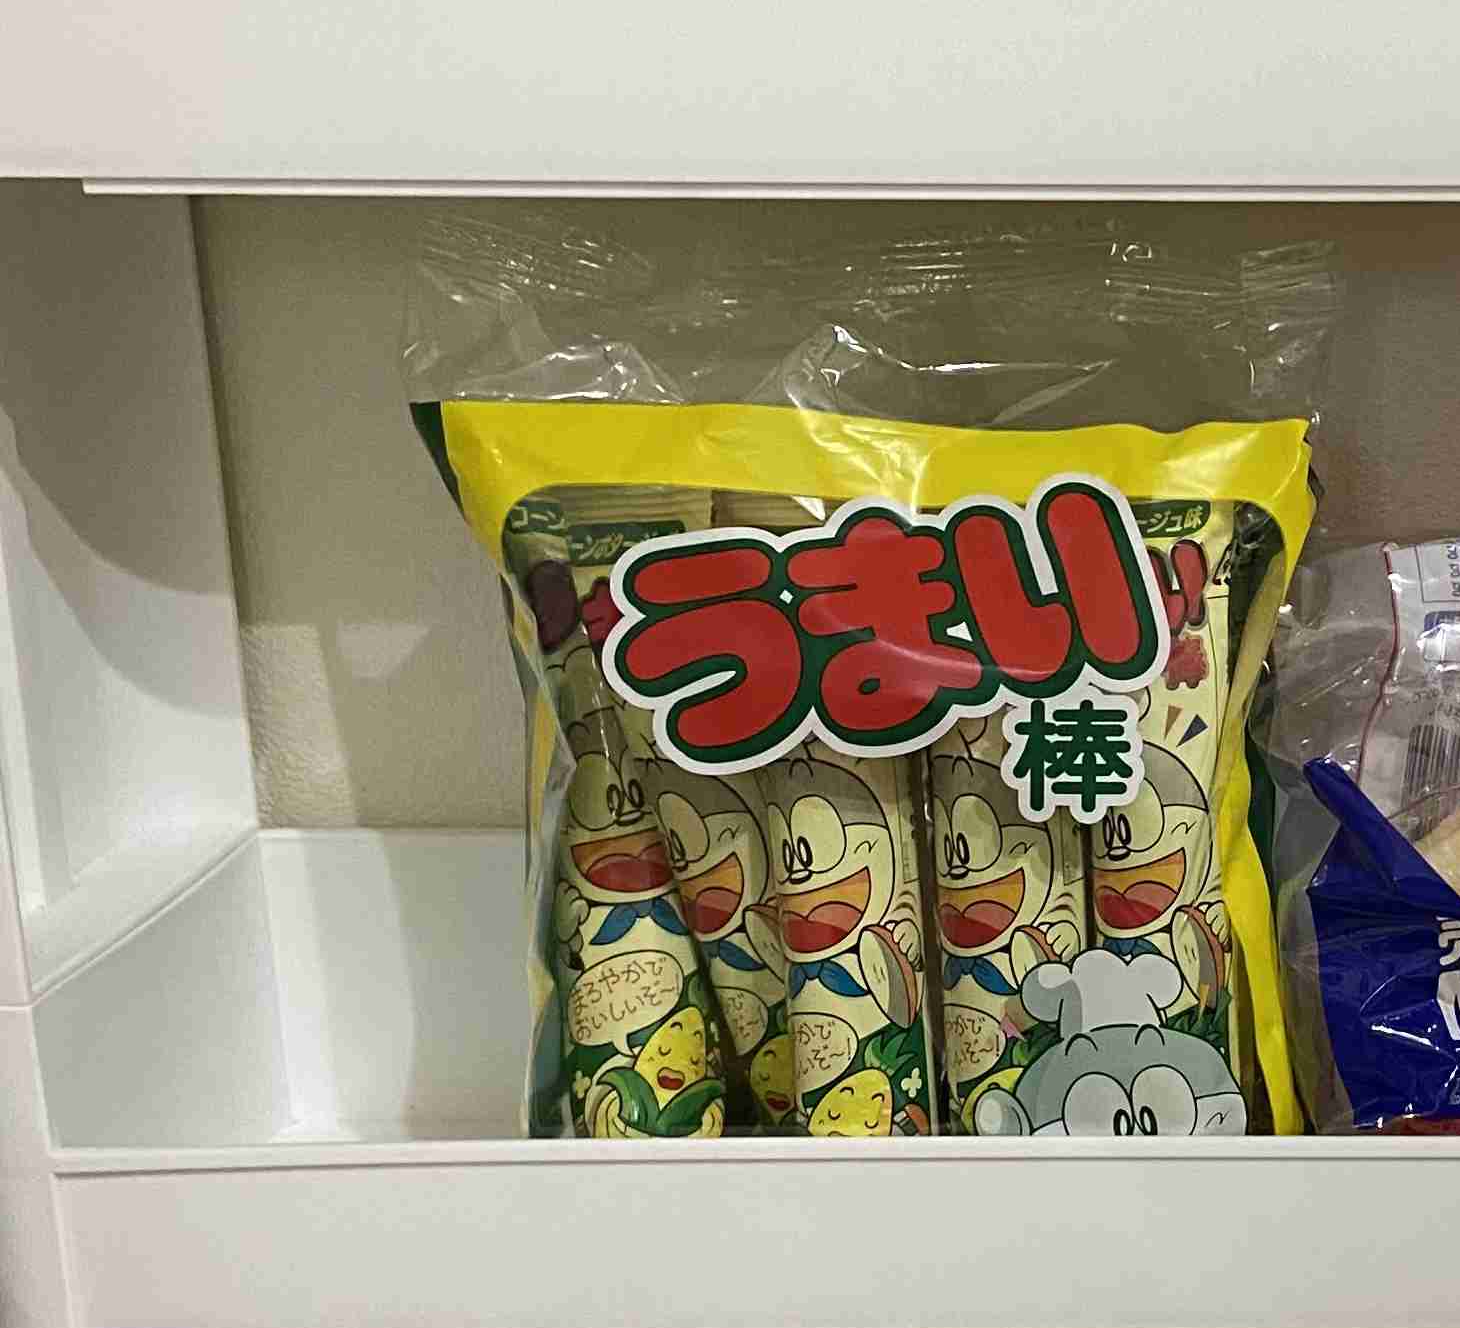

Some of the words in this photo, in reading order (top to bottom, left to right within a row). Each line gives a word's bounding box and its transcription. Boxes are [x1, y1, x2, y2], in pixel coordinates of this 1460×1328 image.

[612, 479, 1163, 769] うまい
[1013, 697, 1132, 815] 棒
